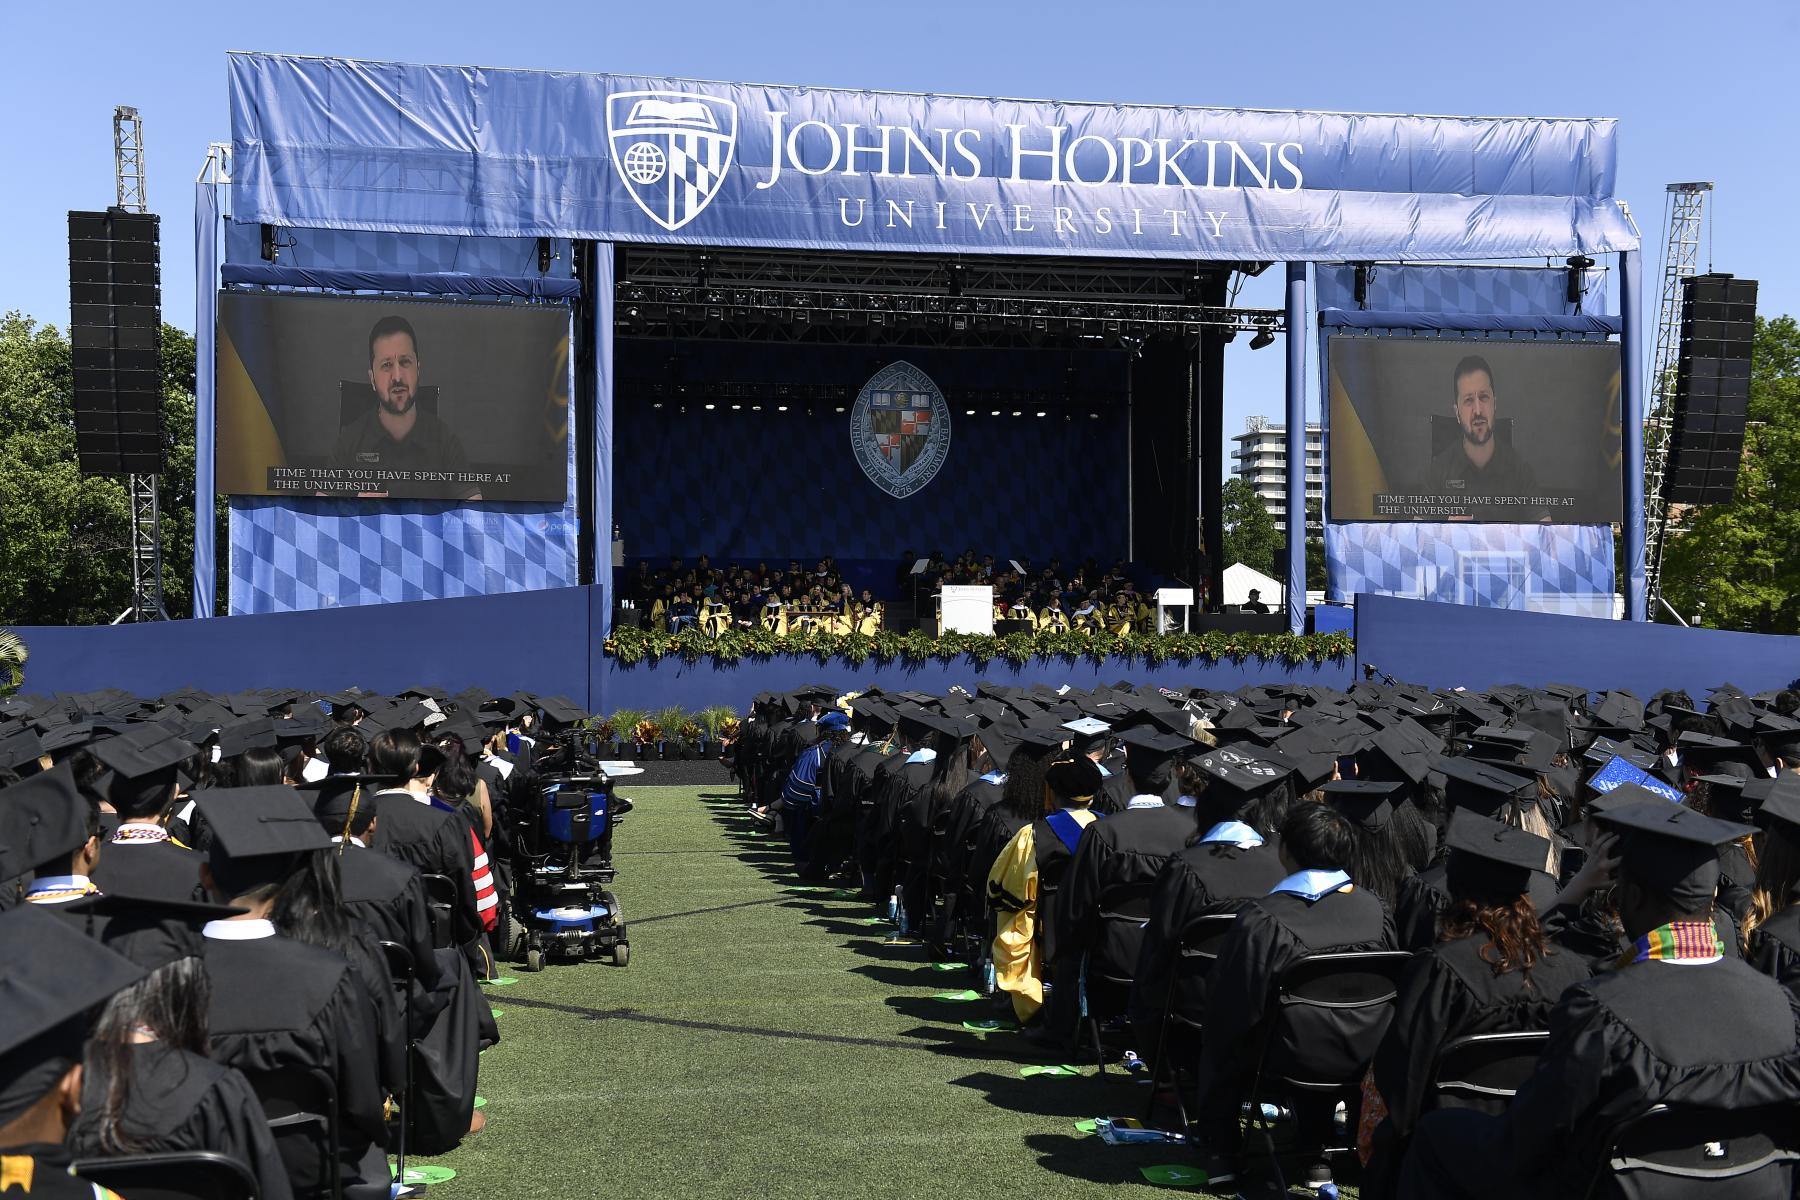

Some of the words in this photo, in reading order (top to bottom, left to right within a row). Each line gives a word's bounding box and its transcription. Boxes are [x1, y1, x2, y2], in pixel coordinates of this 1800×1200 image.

[756, 110, 982, 190] JOHNS
[1005, 123, 1304, 194] HOPKINS
[837, 197, 1229, 238] UNIVERSITY
[273, 468, 307, 478] TIME
[309, 468, 344, 479] THAT
[346, 469, 373, 480] YOU
[376, 470, 411, 480] HAVE
[414, 471, 455, 481] SPENT
[458, 472, 492, 483] HERE
[495, 473, 511, 483] AT
[273, 479, 300, 490] THE
[303, 480, 381, 491] UNIVERSITY
[1378, 495, 1405, 504] TIME
[1407, 495, 1437, 504] THAT
[1438, 495, 1460, 505] YOU
[1463, 496, 1491, 505] HAVE
[1494, 496, 1529, 505] SPENT
[1530, 496, 1559, 506] HERE
[1561, 497, 1575, 506] AT
[1378, 505, 1401, 514] THE
[1403, 505, 1467, 515] UNIVERSITY
